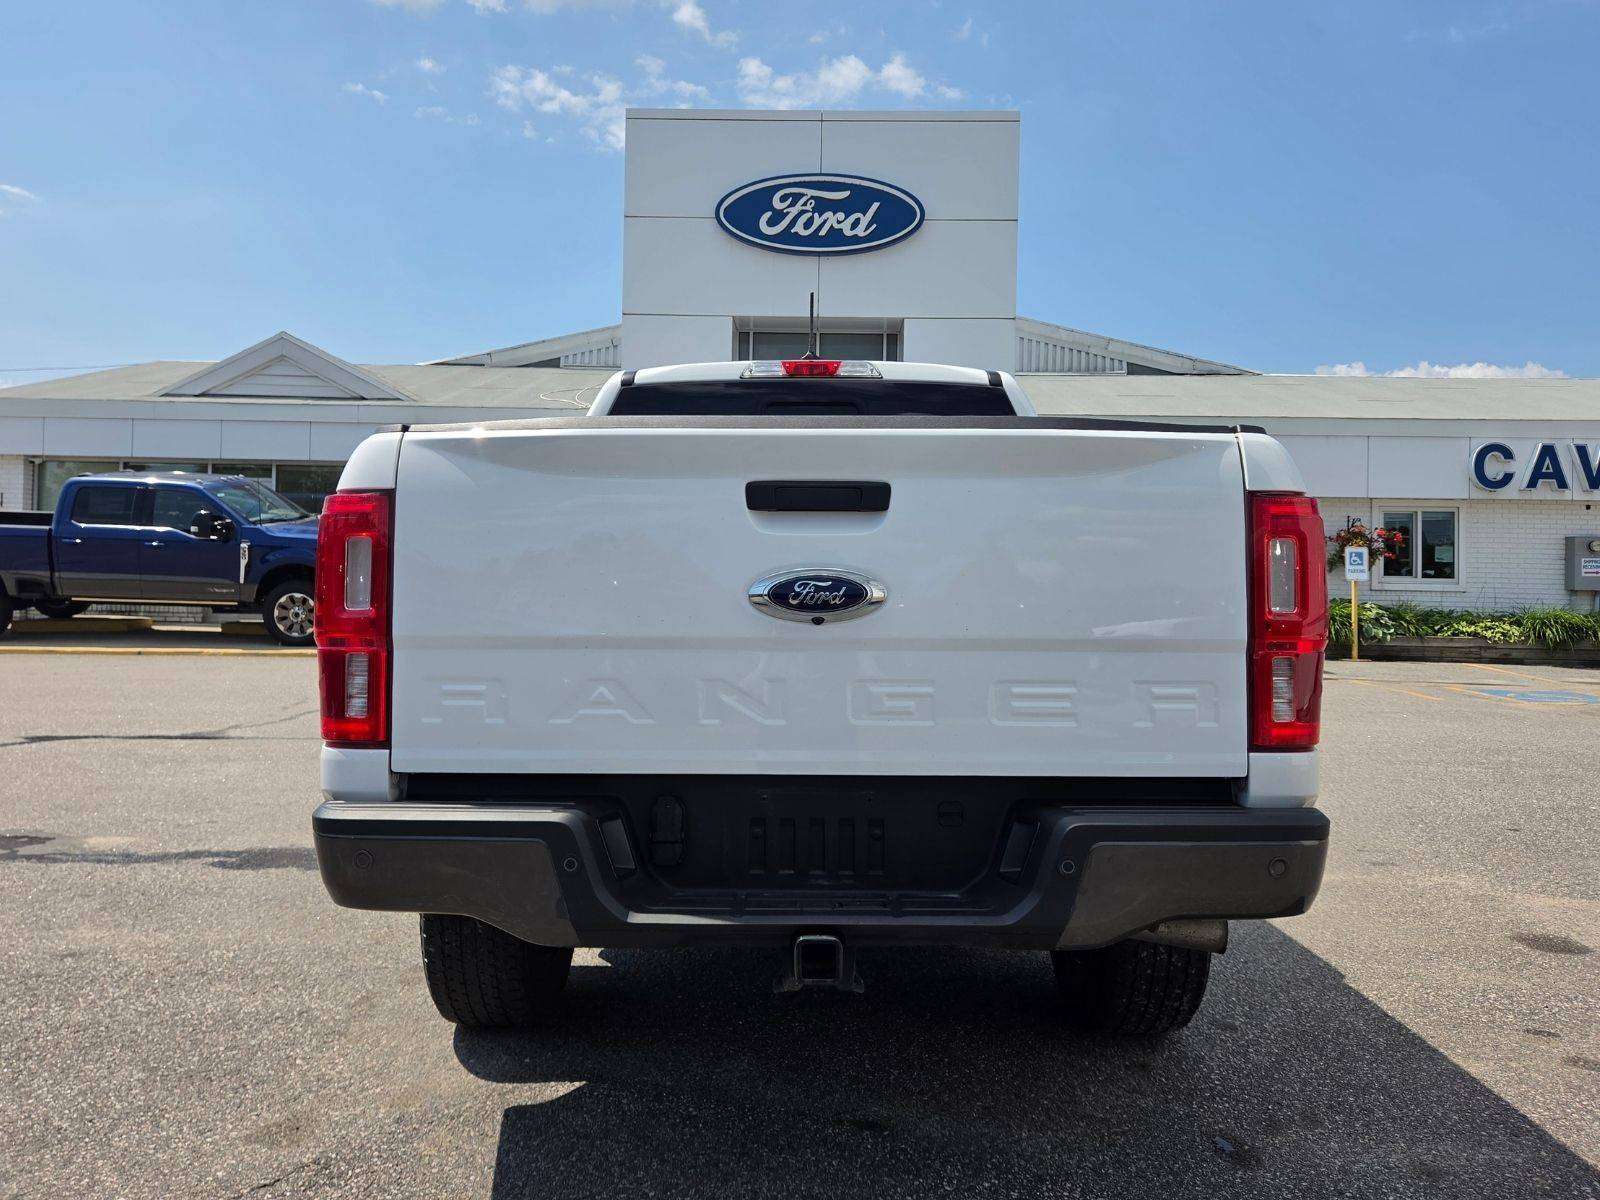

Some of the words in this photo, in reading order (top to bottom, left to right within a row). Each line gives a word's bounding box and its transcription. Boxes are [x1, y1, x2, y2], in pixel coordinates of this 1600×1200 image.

[758, 187, 881, 238] Ford
[788, 580, 847, 605] Ford
[420, 676, 1219, 728] RANGER
